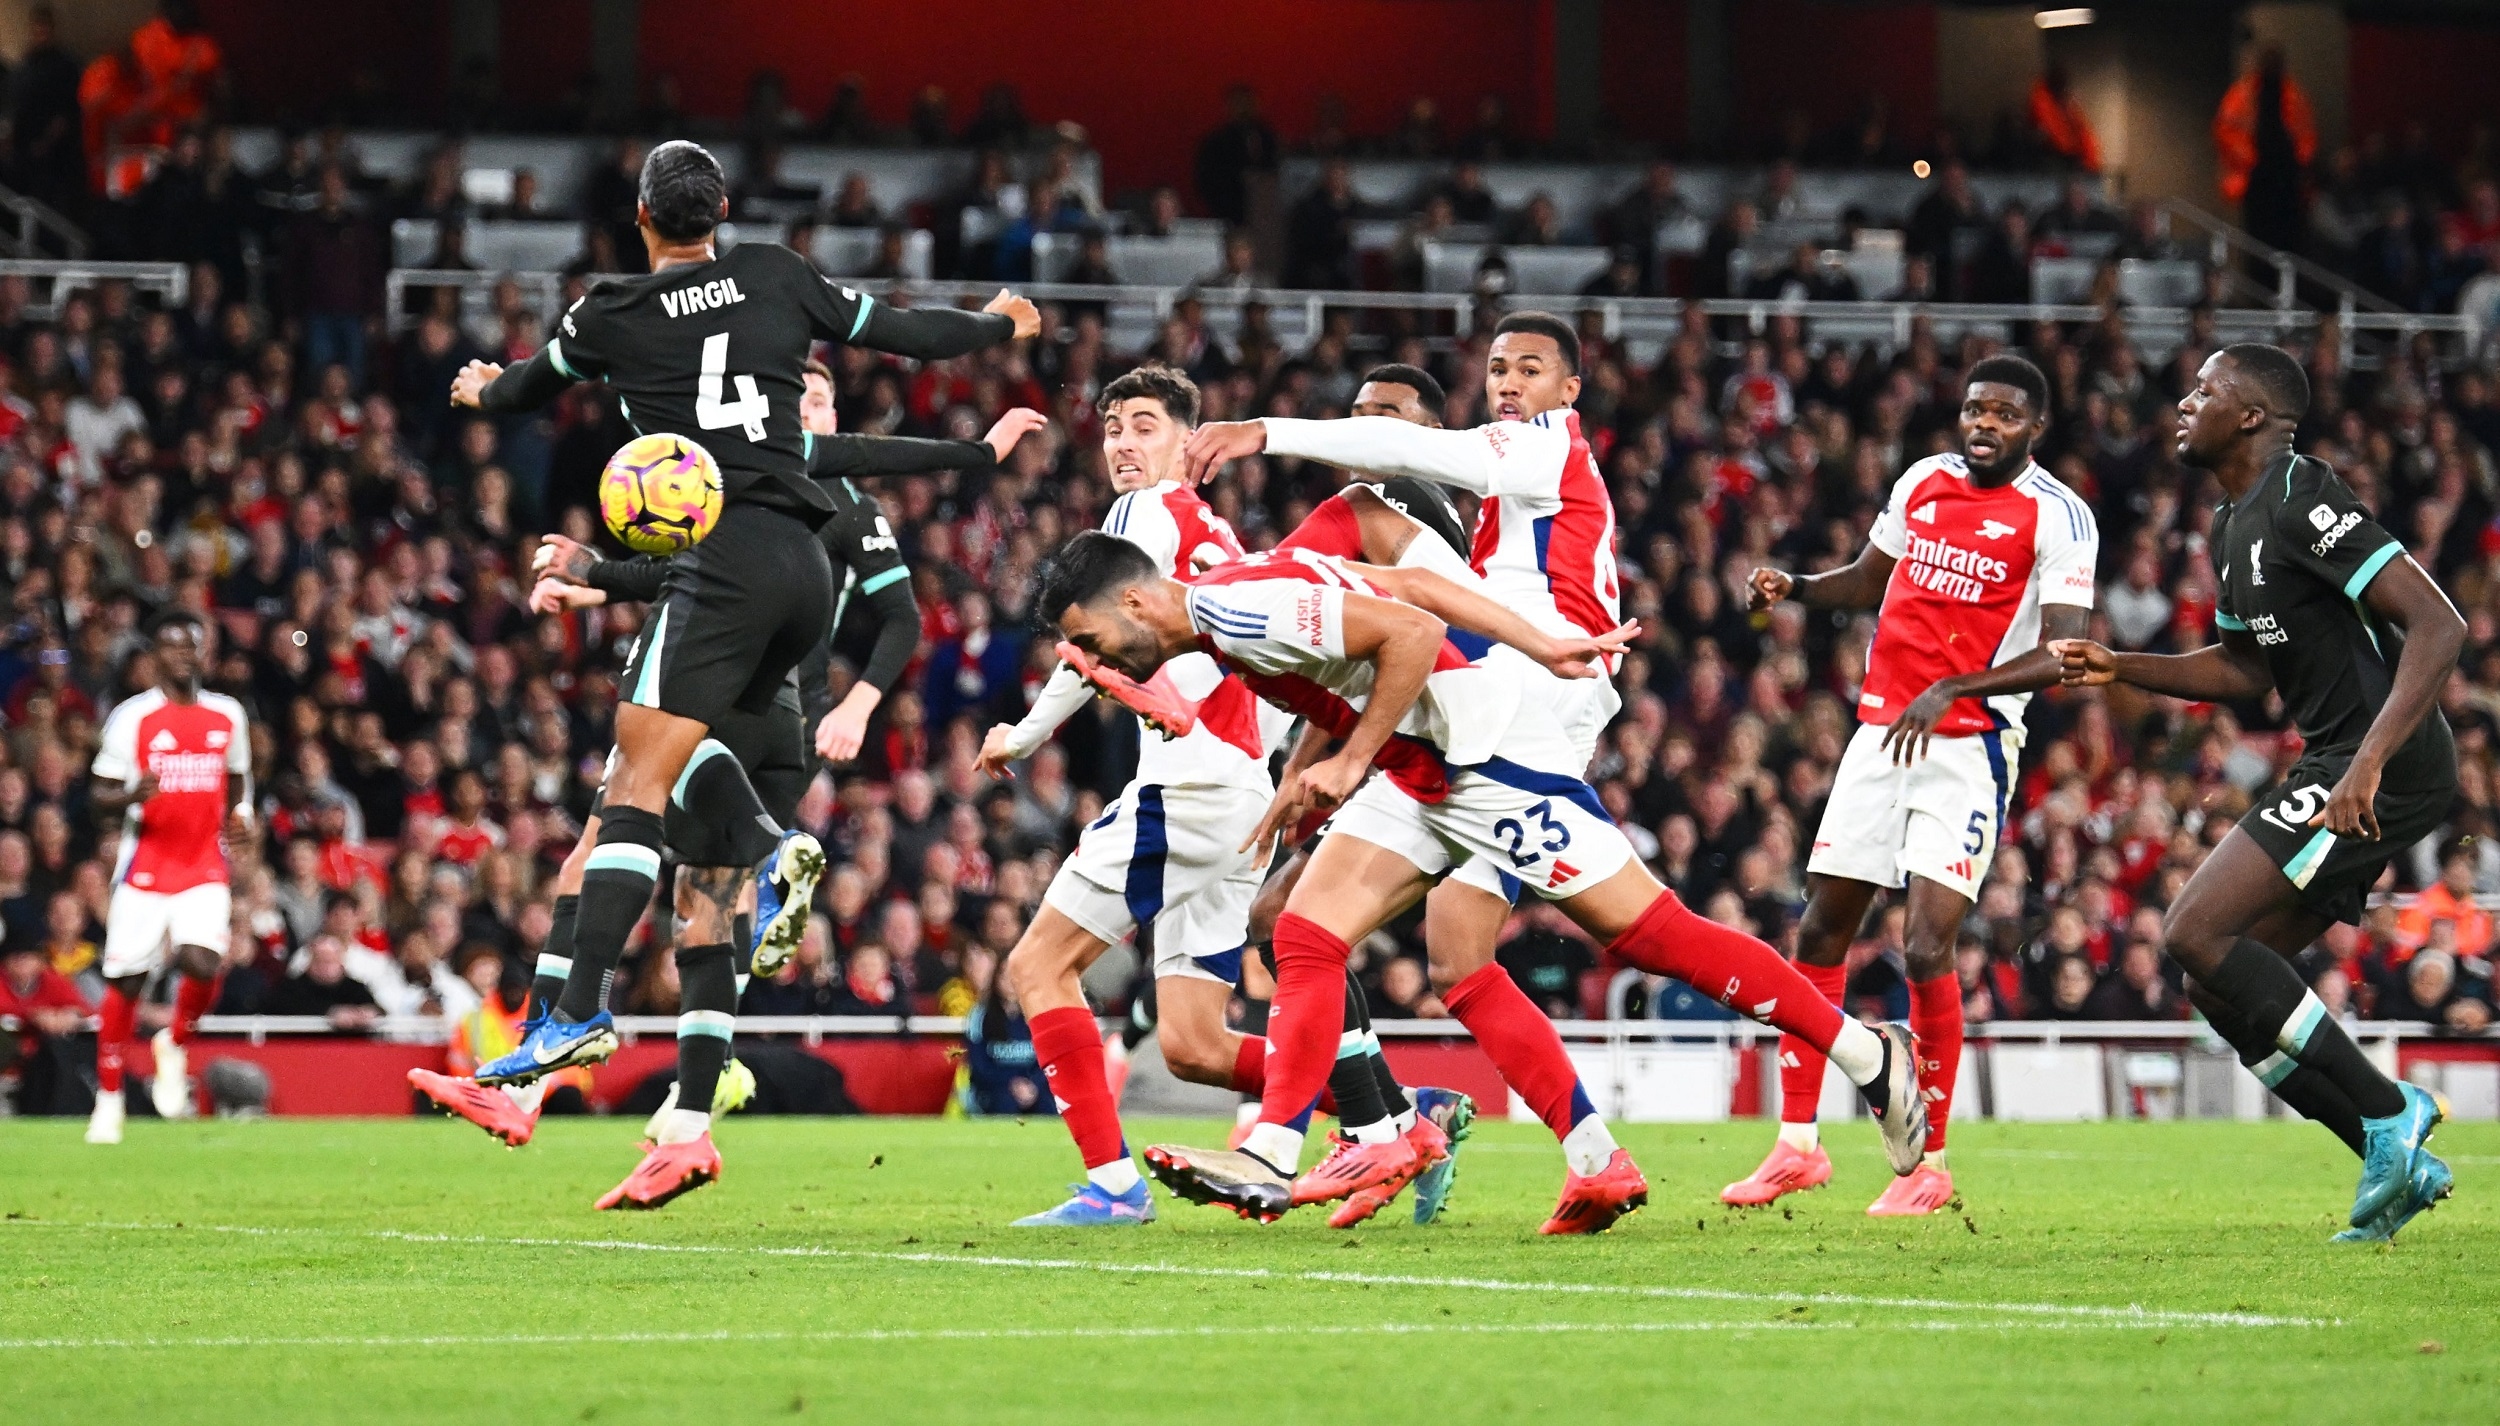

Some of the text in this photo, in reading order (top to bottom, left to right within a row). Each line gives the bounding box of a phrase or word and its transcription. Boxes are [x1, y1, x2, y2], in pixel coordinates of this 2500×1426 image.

[659, 276, 747, 319] VIRGIL
[695, 331, 771, 443] 4
[1490, 426, 1511, 443] ISIT
[1905, 529, 2008, 583] Emirates
[2311, 511, 2363, 558] Expedia
[1927, 568, 1985, 603] BETTER
[1297, 597, 1310, 633] VISIT
[1310, 588, 1323, 646] RWANDA
[2279, 783, 2331, 824] 5
[1493, 798, 1571, 869] 23
[1963, 809, 1988, 856] 5
[1720, 976, 1741, 1006] FC
